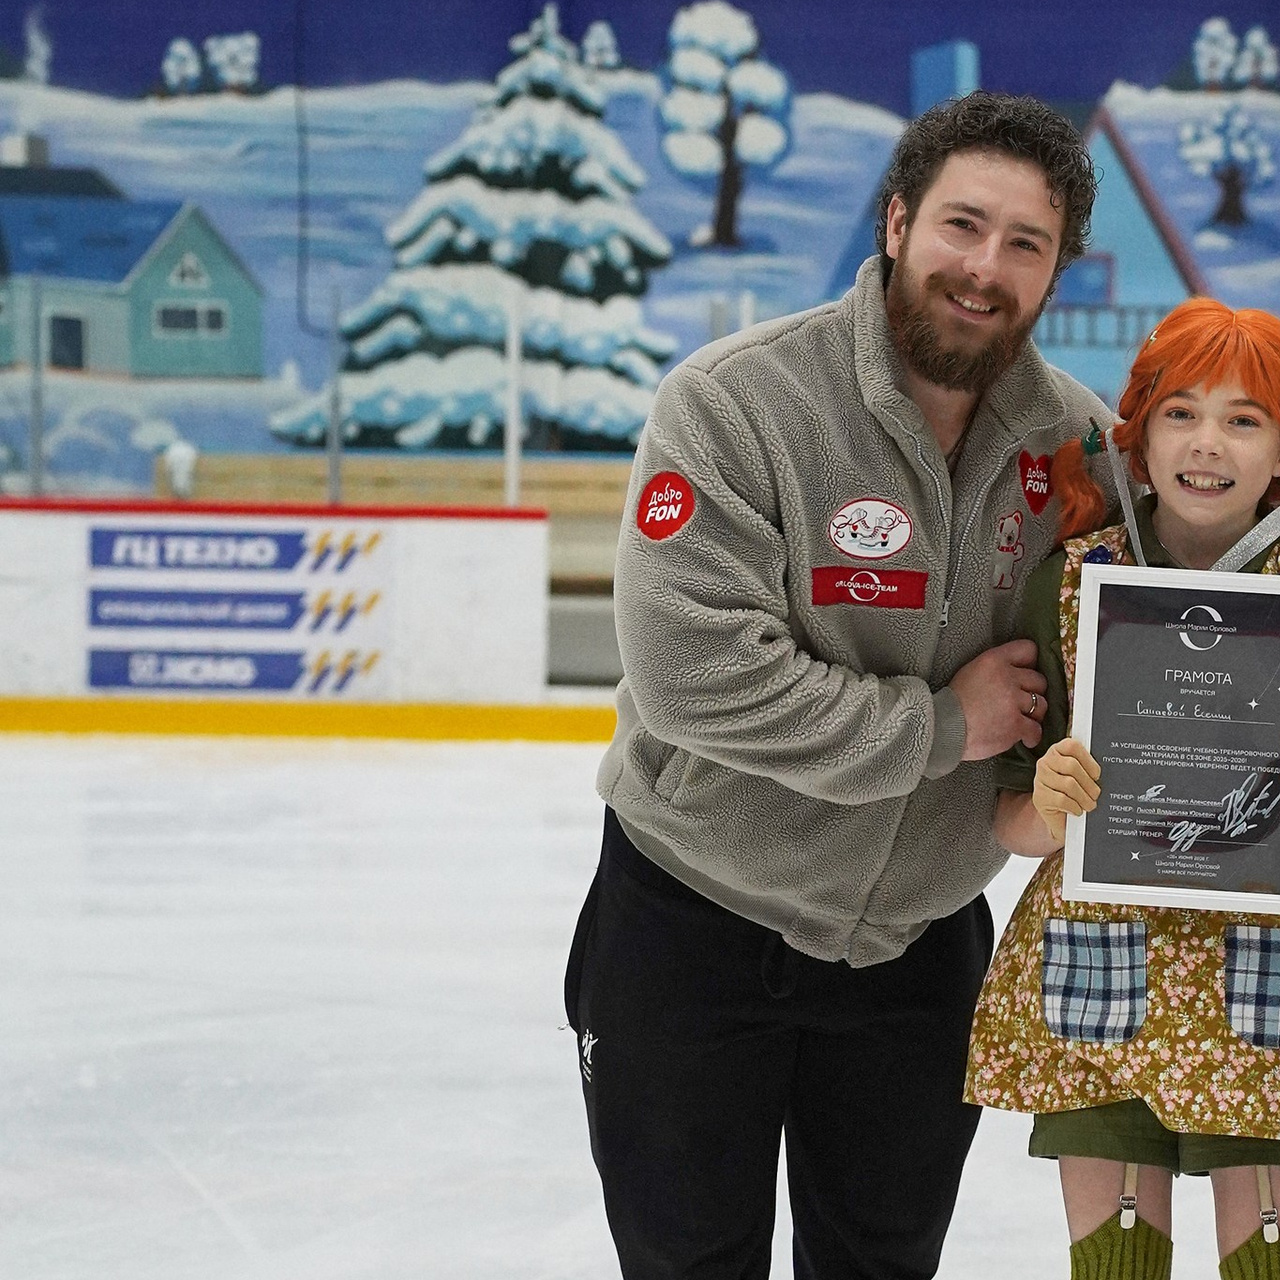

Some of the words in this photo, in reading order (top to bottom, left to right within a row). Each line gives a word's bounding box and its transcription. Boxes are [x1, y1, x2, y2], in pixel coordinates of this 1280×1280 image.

[1026, 464, 1048, 480] Добро
[1025, 480, 1048, 494] FON
[648, 482, 683, 507] Добро
[645, 503, 683, 523] FON
[1165, 622, 1187, 630] Школа
[1187, 623, 1209, 632] Марии
[1164, 669, 1233, 685] ГРАМОТА
[1180, 688, 1216, 696] ВРУЧАЕТСЯ
[1120, 742, 1155, 750] УСПЕШНОЕ
[1156, 744, 1192, 752] ОСВОЕНИЕ
[1141, 751, 1180, 760] МАТЕРИАЛА
[1186, 754, 1212, 762] СЕЗОНЕ
[1153, 759, 1195, 767] ТРЕНИРОВКА
[1195, 762, 1229, 770] УВЕРЕННО
[1108, 816, 1134, 824] ТРЕНЕР:
[1107, 828, 1138, 836] СТАРШИЙ
[1138, 830, 1164, 838] ТРЕНЕР:
